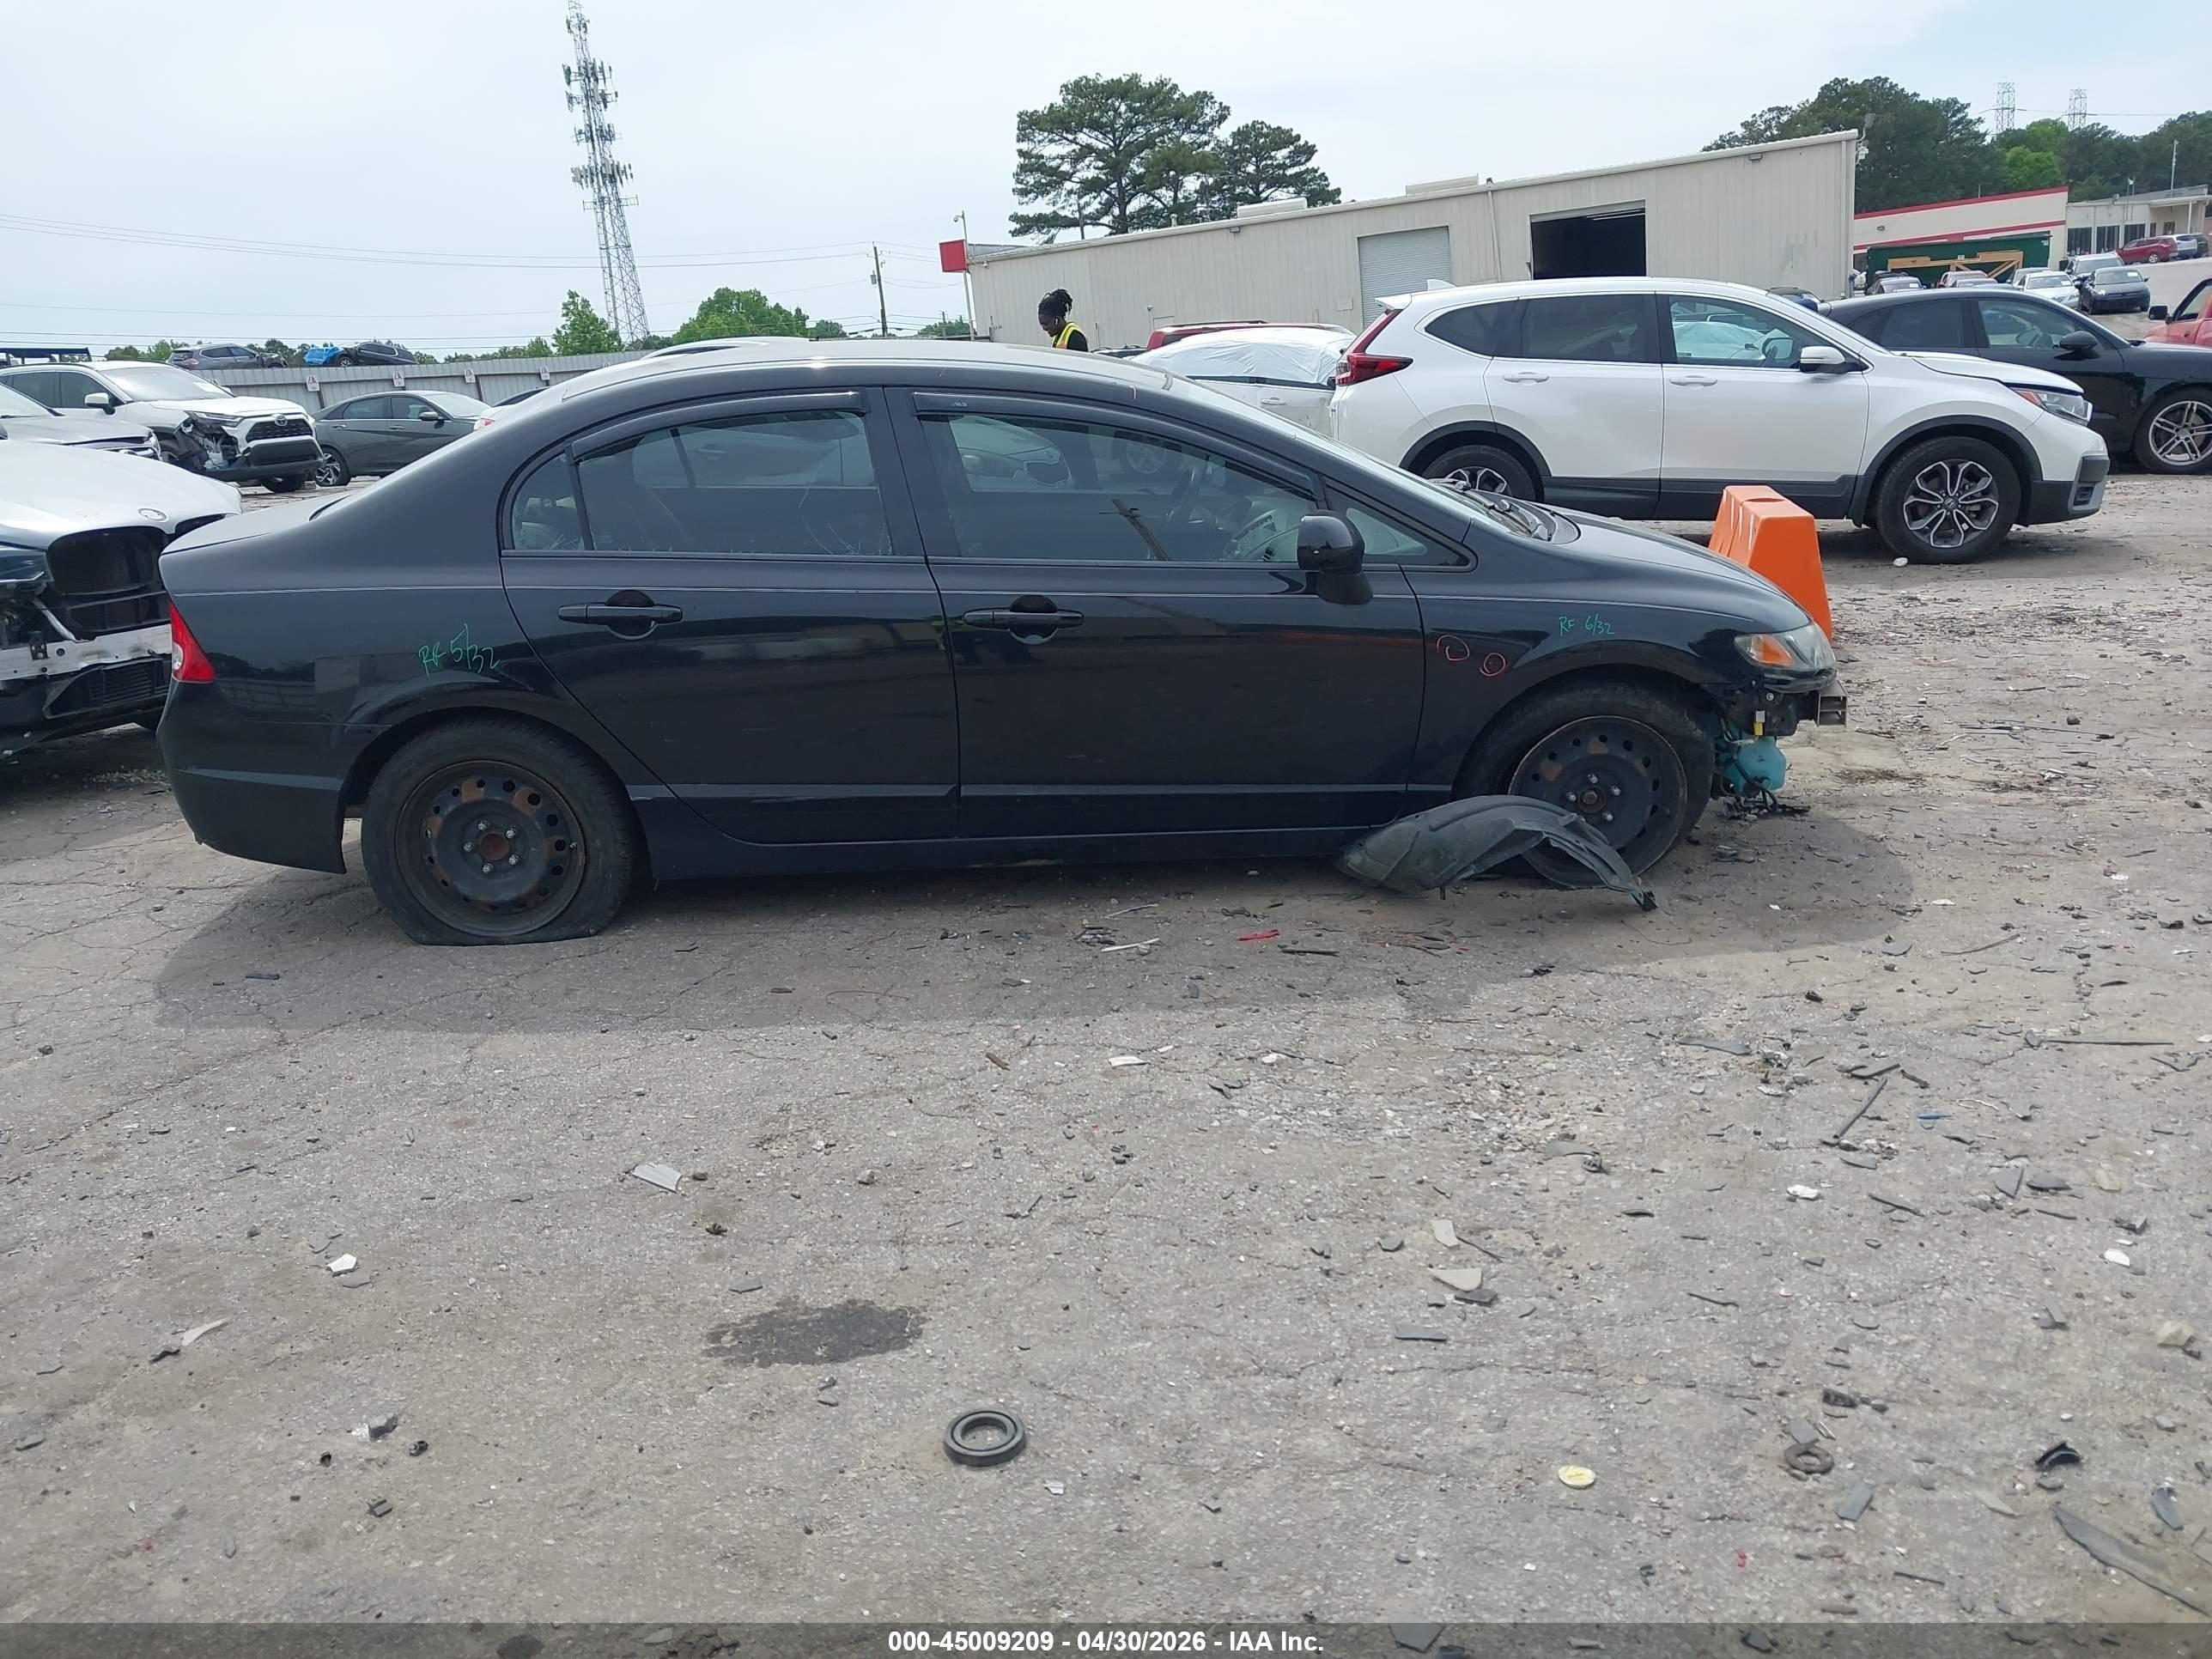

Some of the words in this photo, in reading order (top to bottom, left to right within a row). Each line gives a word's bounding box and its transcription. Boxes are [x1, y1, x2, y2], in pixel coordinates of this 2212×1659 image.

[1559, 616, 1576, 637] RF
[1584, 613, 1616, 636] 6/32
[450, 623, 501, 674] 5/32
